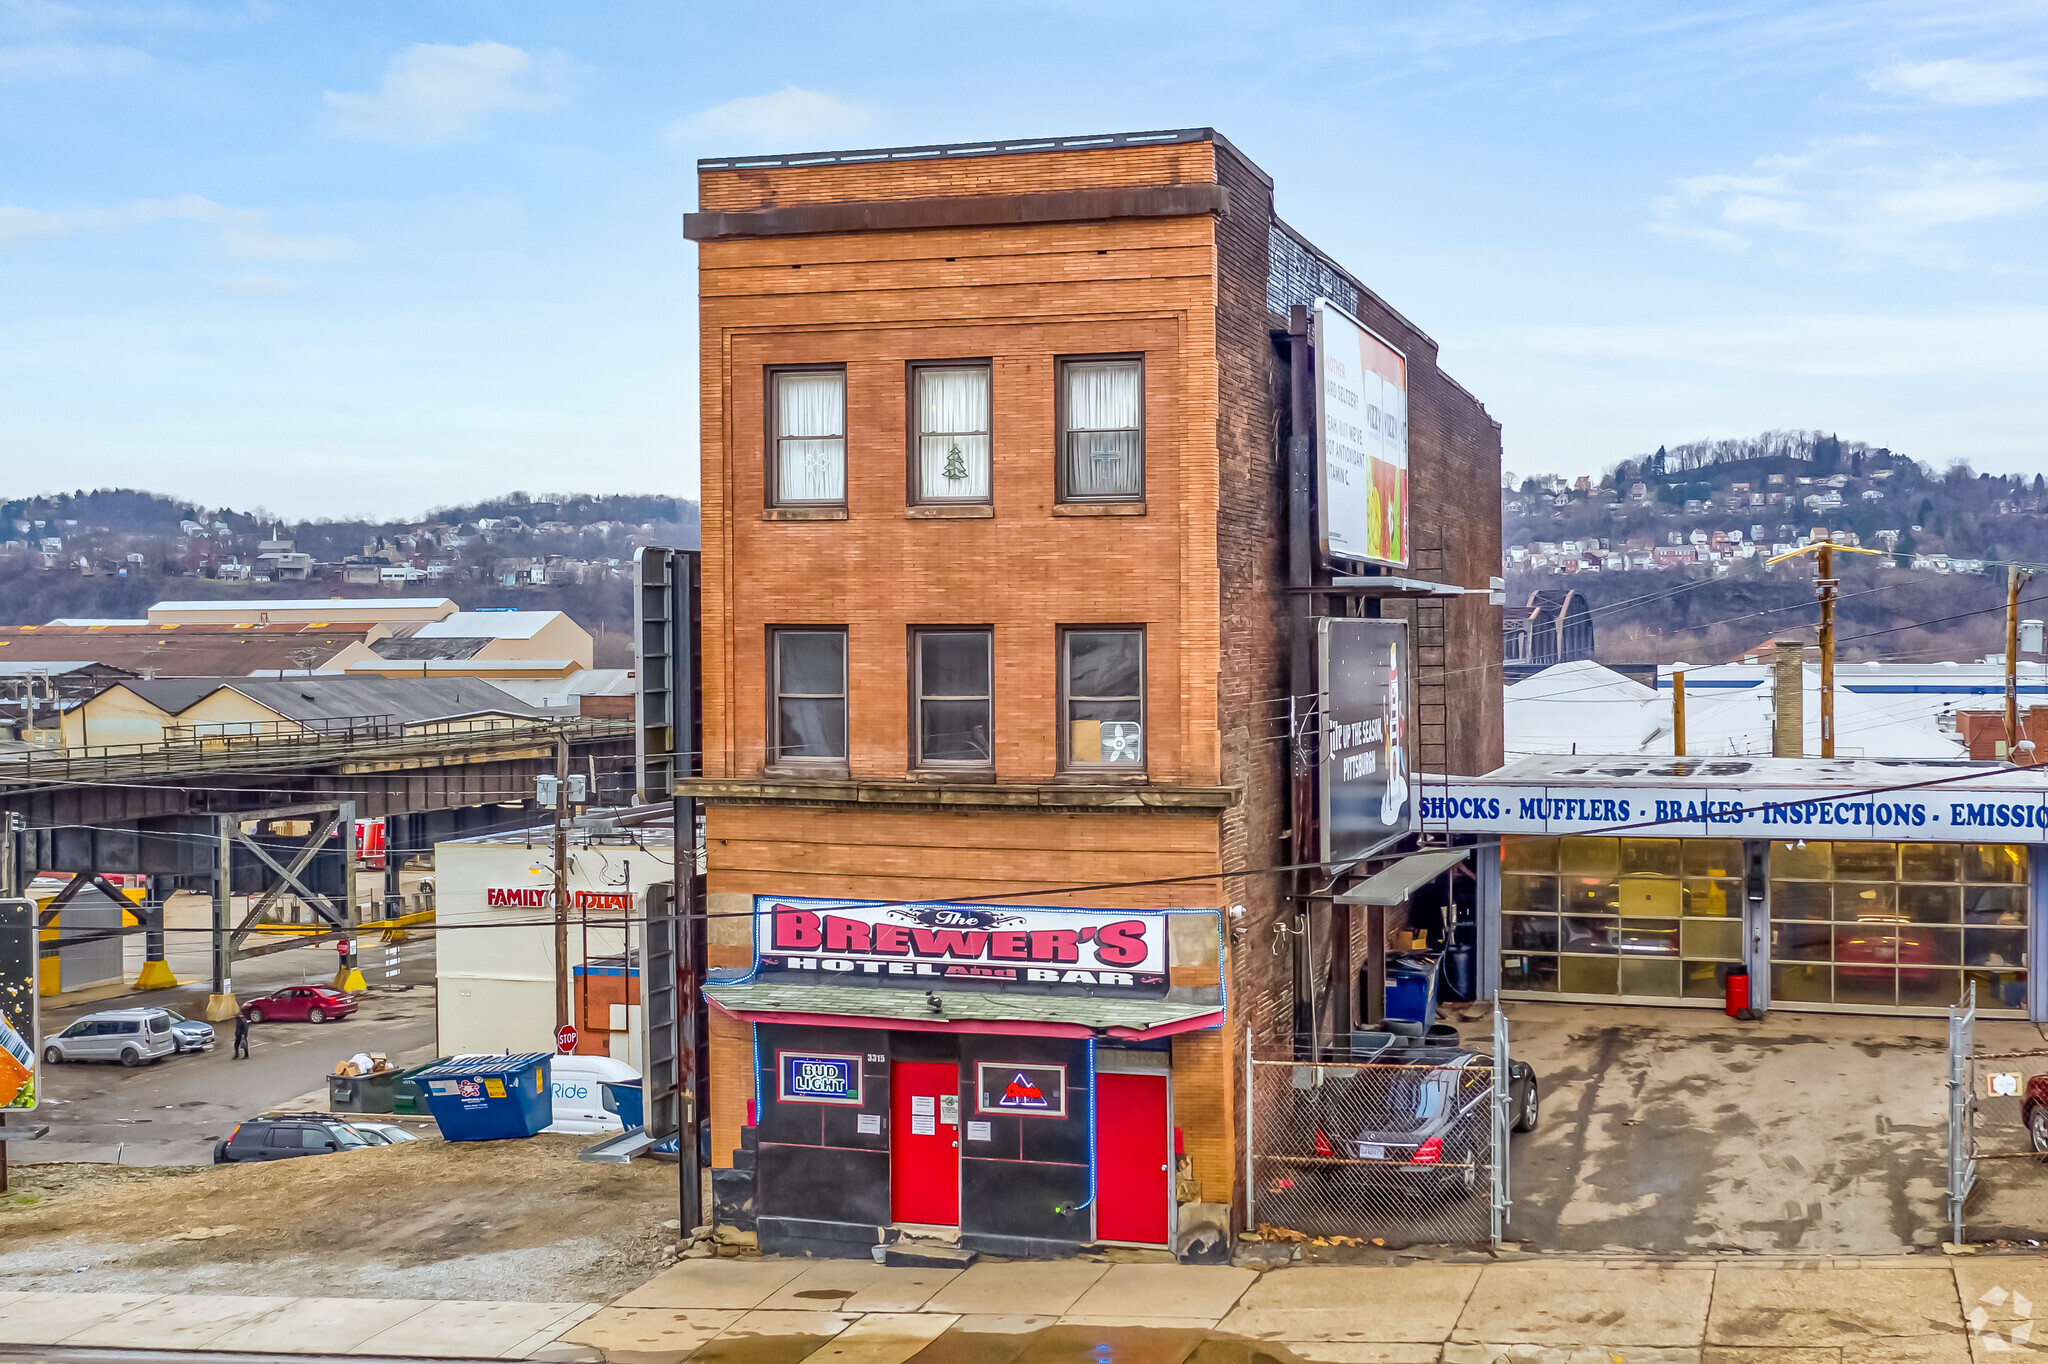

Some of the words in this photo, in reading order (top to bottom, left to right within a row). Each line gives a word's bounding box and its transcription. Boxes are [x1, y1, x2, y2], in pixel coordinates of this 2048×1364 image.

[1325, 355, 1345, 379] NOTHER
[1366, 403, 1381, 432] VIZZY
[1342, 724, 1351, 749] UP
[1351, 721, 1362, 747] THE
[1362, 717, 1383, 743] SEASON,
[1343, 750, 1376, 782] PITTSBURGH
[1419, 796, 1500, 820] SHOCKS
[1519, 797, 1630, 821] MUFFLERS
[1655, 799, 1743, 823] BRAKES
[1762, 801, 1926, 826] INSPECTIONS
[1950, 803, 2048, 829] EMISSIO
[487, 887, 545, 907] FAMILY
[935, 909, 979, 926] The
[772, 903, 1148, 967] BREWER'S
[787, 956, 941, 977] HOTEL
[945, 966, 1017, 977] And
[1027, 968, 1134, 986] BAR
[559, 1032, 577, 1045] STOP
[867, 1053, 885, 1063] 3315
[802, 1063, 838, 1079] BUD
[551, 1082, 588, 1099] Ride
[795, 1076, 845, 1093] LIGHT
